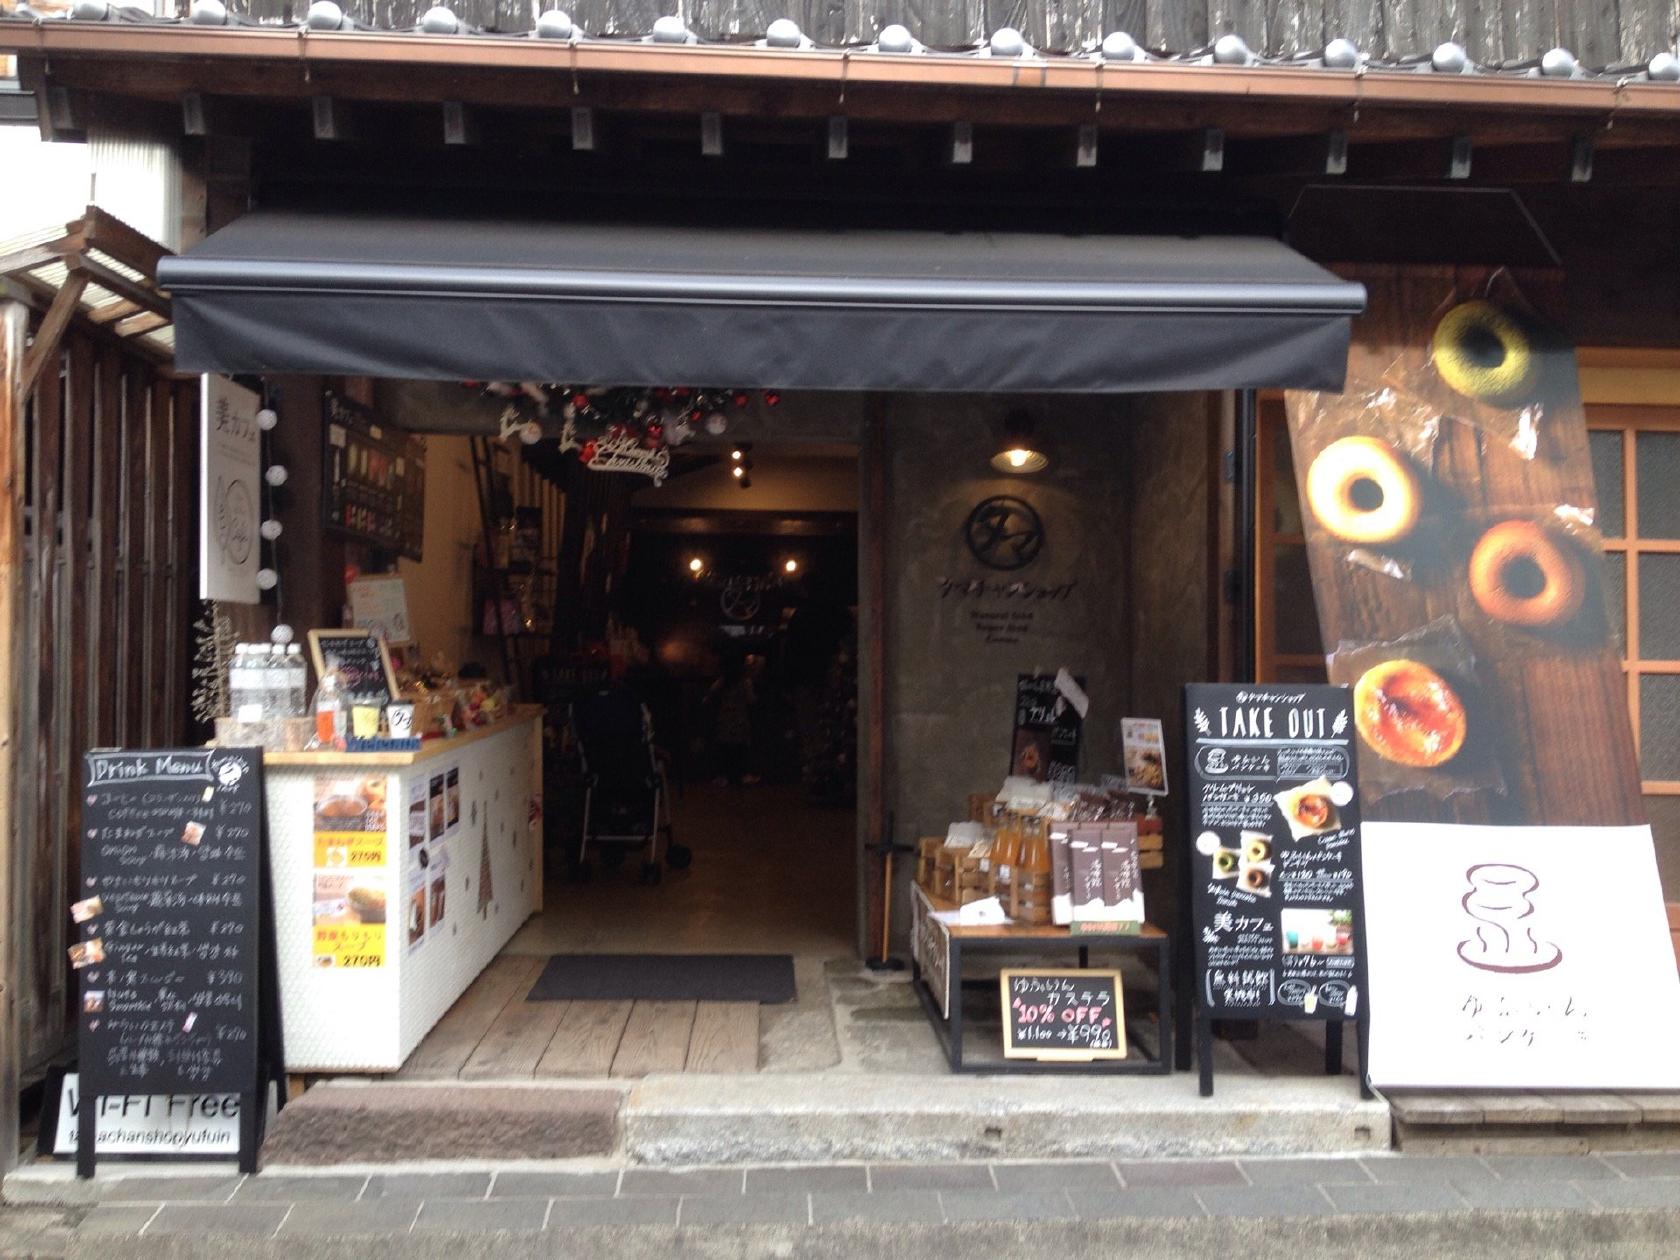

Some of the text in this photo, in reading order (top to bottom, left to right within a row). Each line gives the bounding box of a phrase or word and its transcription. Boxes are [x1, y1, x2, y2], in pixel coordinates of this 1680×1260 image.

[1219, 706, 1325, 738] TAKE OUT
[95, 758, 148, 779] Drink
[1047, 991, 1110, 1007] カステラ
[1018, 1003, 1102, 1025] 10% OFF
[69, 1129, 230, 1146] taachanshopyufuin
